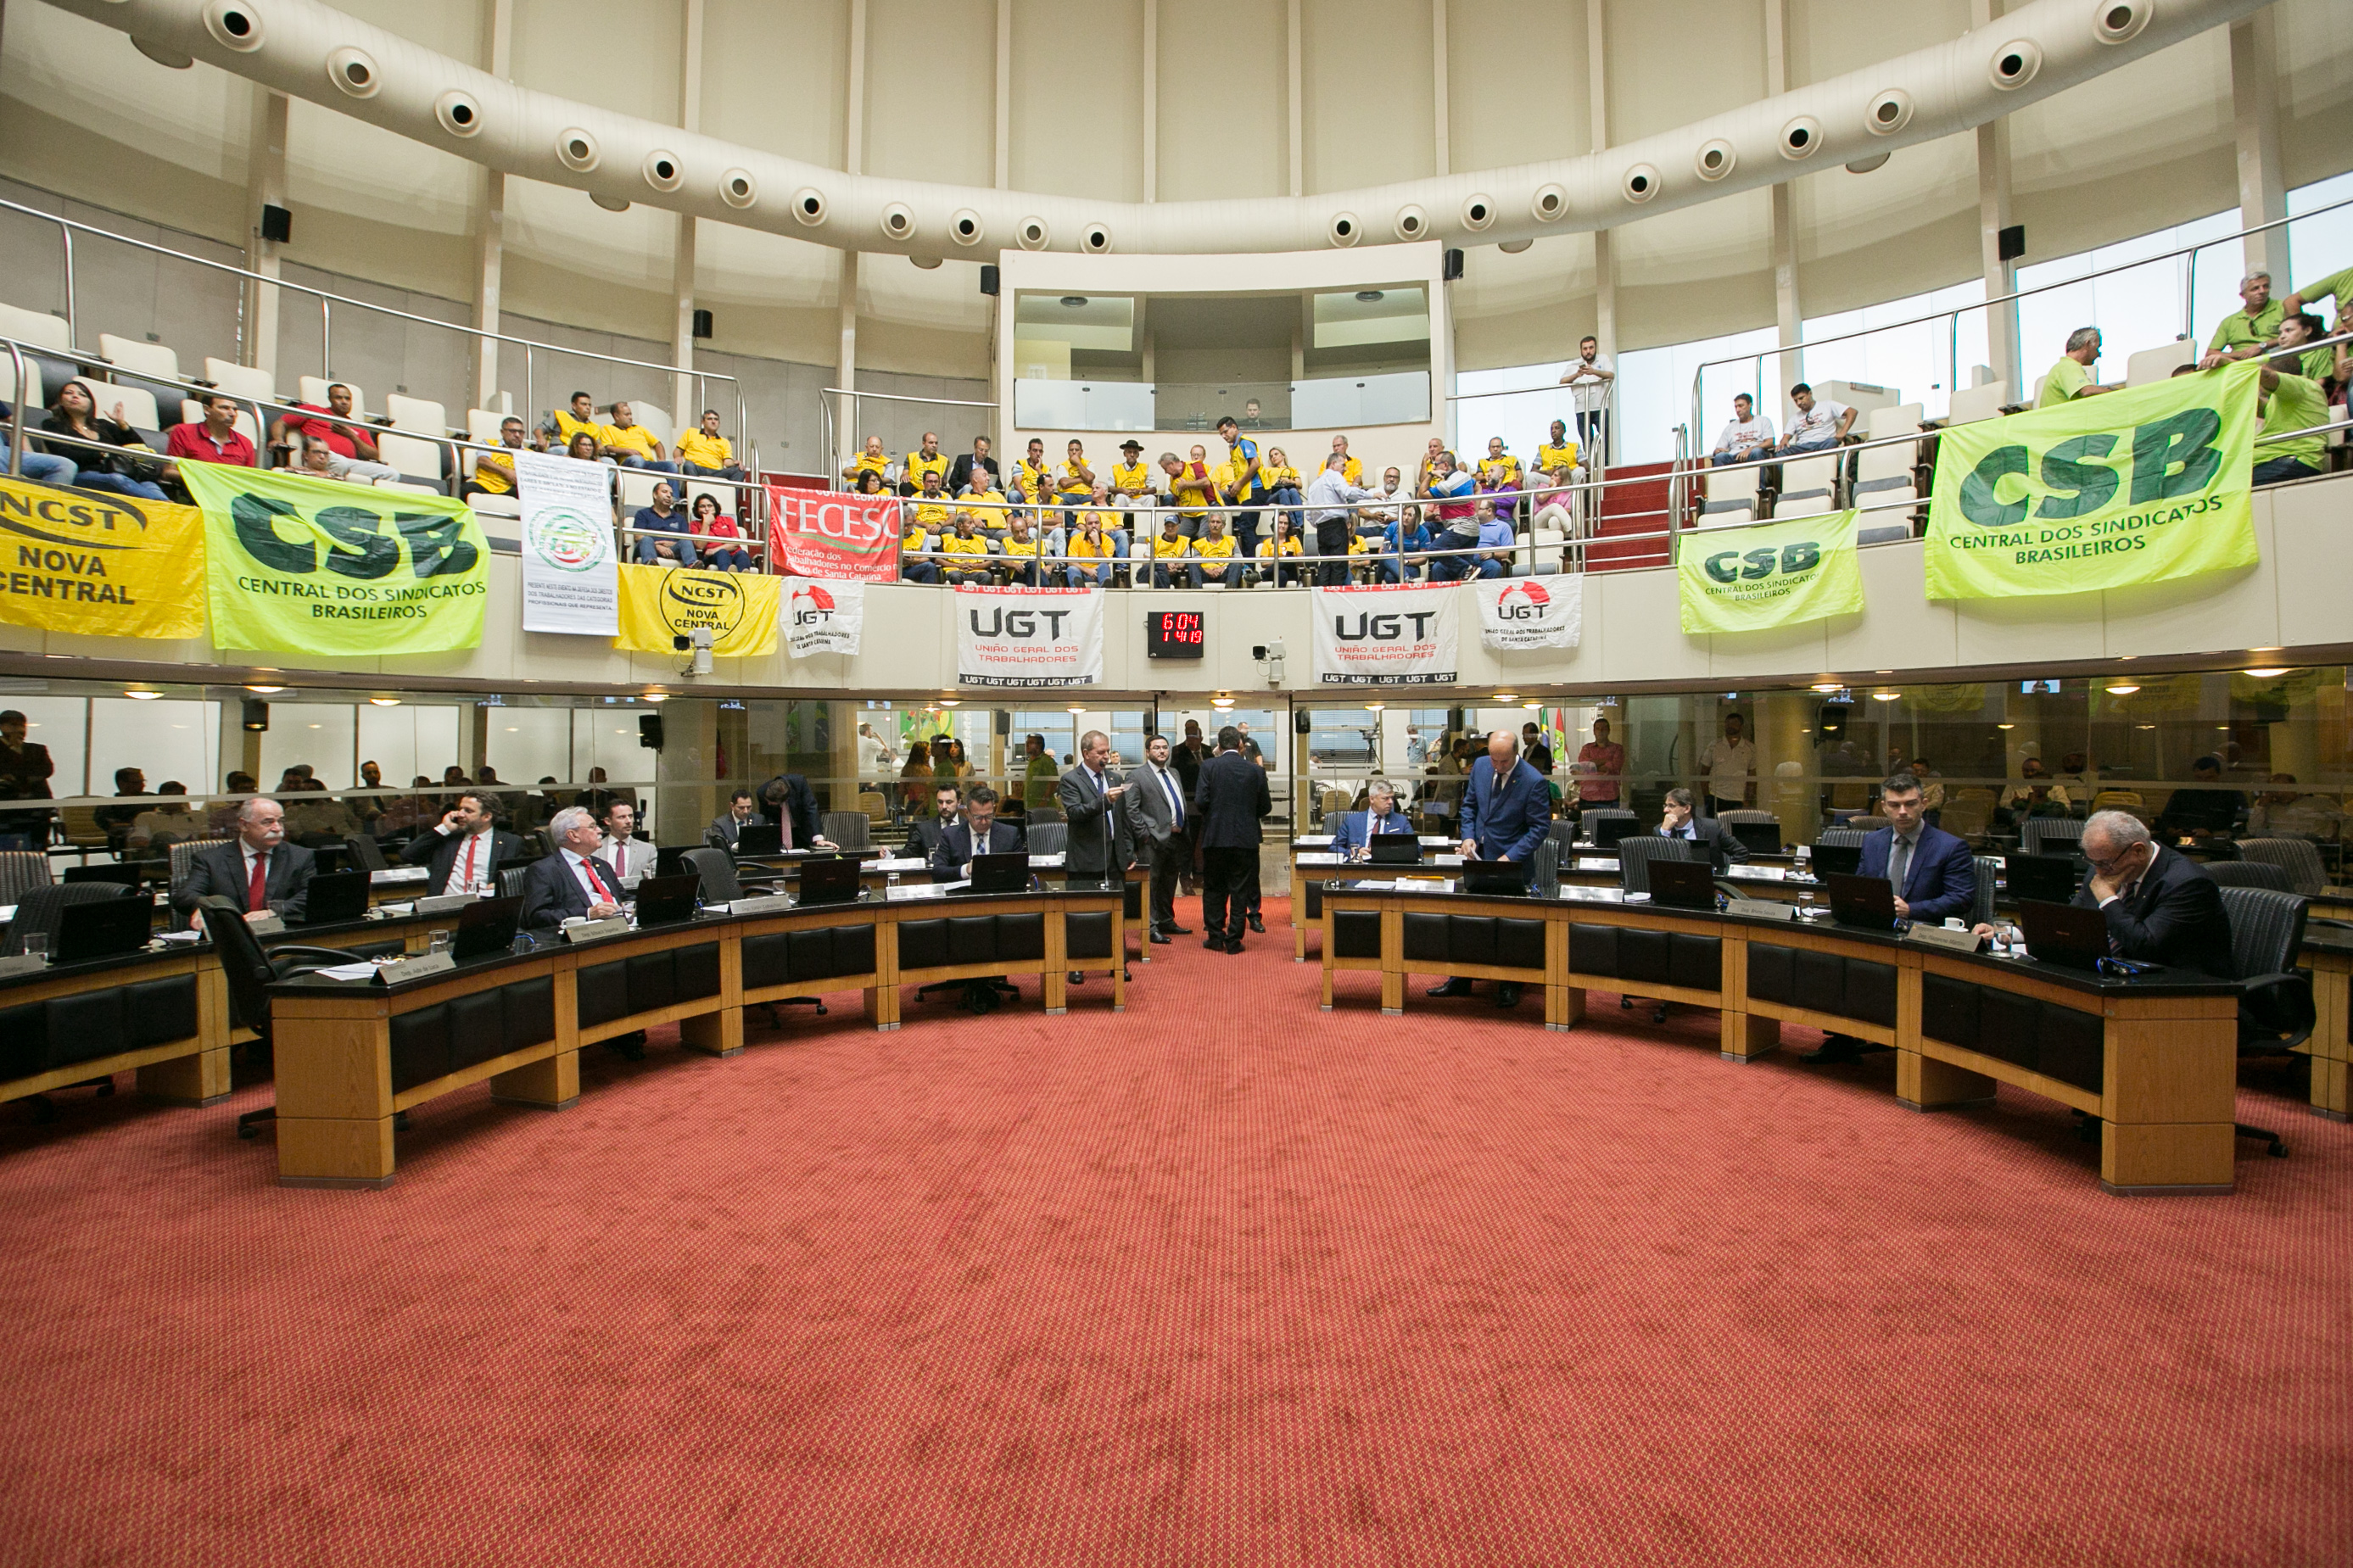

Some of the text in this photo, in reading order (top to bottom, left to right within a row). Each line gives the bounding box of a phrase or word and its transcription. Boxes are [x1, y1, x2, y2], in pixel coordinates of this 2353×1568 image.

[1959, 407, 2223, 527] CSB
[0, 491, 121, 530] NCST
[780, 494, 899, 540] FECESC
[232, 492, 478, 579] CSB
[1950, 532, 2033, 550] CENTRAL
[2040, 525, 2082, 543] DOS
[827, 551, 841, 561] dos
[2015, 535, 2146, 565] BRASILEIROS
[19, 545, 107, 577] NOVA
[853, 563, 891, 572] Comércio
[1704, 541, 1820, 583] CSB
[812, 566, 823, 576] de
[824, 569, 847, 579] Santa
[848, 572, 882, 581] Catarina
[238, 577, 486, 601] CENTRAL DOS SINDICATOS
[681, 585, 726, 598] NCST
[1705, 586, 1743, 595] CENTRAL
[1745, 583, 1764, 591] DOS
[1735, 588, 1791, 601] BRASILEIROS
[312, 604, 428, 619] BRASILEIROS
[687, 609, 718, 620] NOVA
[1498, 604, 1549, 619] UGT
[674, 619, 729, 630] CENTRAL
[970, 606, 1072, 641] UGT
[1336, 611, 1437, 642] UGT
[975, 644, 1009, 652] UNIÃO
[1335, 644, 1367, 653] UNIÃO
[979, 654, 1076, 663] TRABALHADORES
[1337, 651, 1434, 661] TRABALHADORES
[964, 676, 1087, 686] UGT UGT UGT UGT UGT UGT
[1325, 674, 1346, 683] UGT
[1351, 675, 1372, 684] UGT
[1379, 675, 1400, 684] UGT
[1434, 673, 1455, 682] UGT
